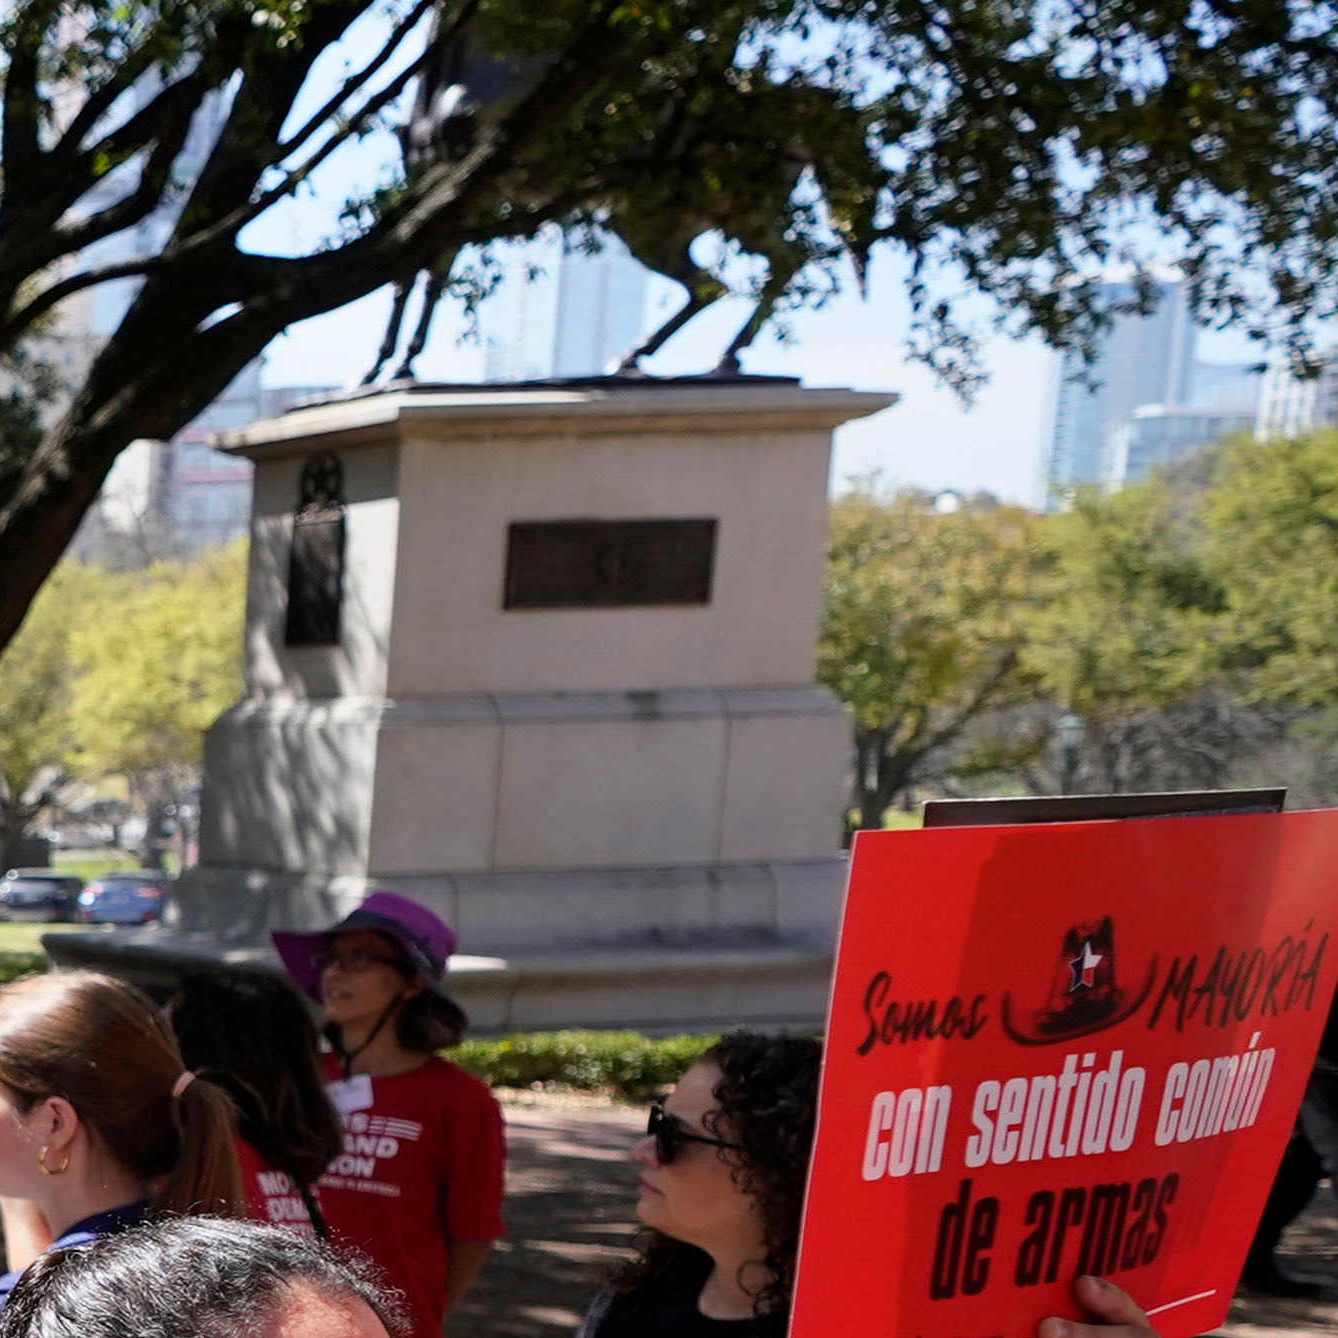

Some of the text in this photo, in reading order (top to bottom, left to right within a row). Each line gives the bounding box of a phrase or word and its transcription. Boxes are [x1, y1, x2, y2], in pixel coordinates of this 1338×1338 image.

[856, 970, 988, 1055] Somos
[861, 1031, 1276, 1182] con sentido común
[930, 1172, 1181, 1303] de armas
